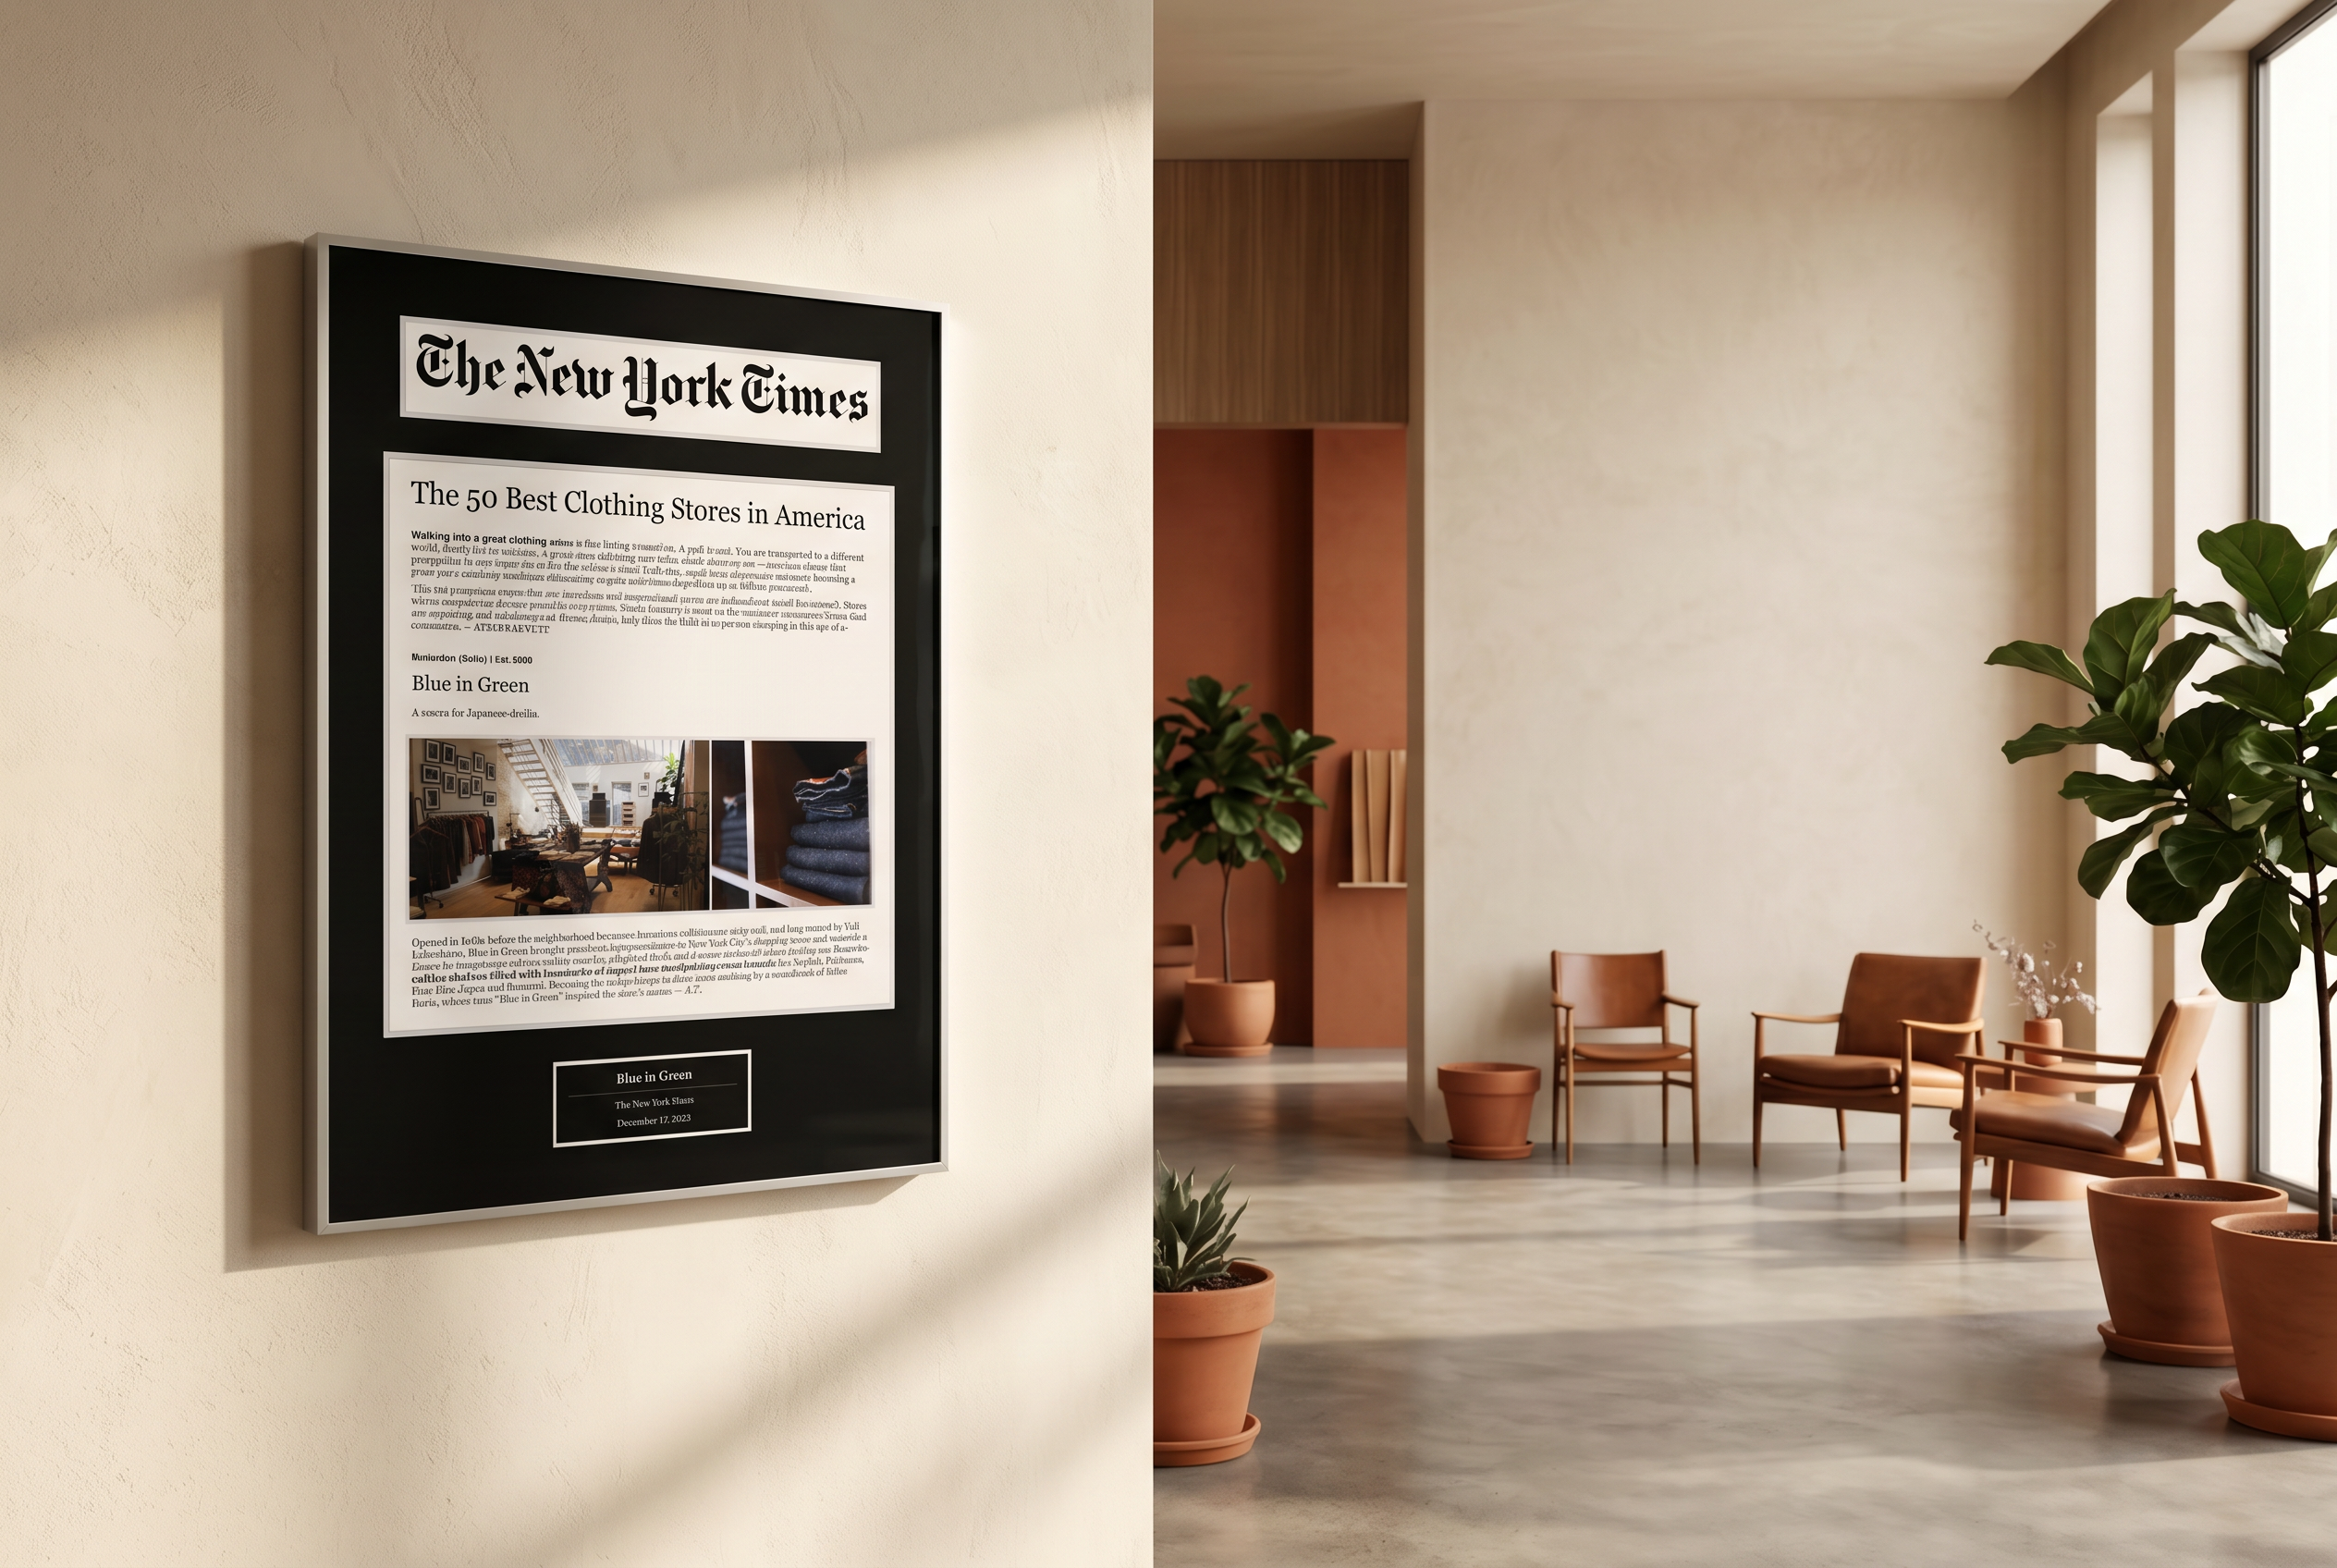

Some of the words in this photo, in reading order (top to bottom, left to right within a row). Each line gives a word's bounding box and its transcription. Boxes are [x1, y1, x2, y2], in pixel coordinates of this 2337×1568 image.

[416, 334, 507, 396] The
[514, 344, 614, 399] New
[623, 356, 735, 421] York
[741, 363, 868, 423] Times
[410, 481, 459, 506] The
[466, 489, 497, 512] 50
[506, 486, 557, 511] Best
[564, 490, 664, 524] Clothing
[671, 497, 740, 522] Stores
[748, 501, 768, 524] in
[774, 505, 865, 531] America
[411, 531, 449, 542] Walking
[453, 533, 471, 542] into
[483, 535, 507, 544] great
[509, 536, 546, 547] clothing
[604, 540, 630, 552] linting
[679, 545, 685, 553] A
[736, 547, 751, 556] You
[831, 552, 863, 561] different
[727, 607, 739, 616] the
[800, 622, 814, 631] this
[831, 623, 839, 631] of
[459, 655, 487, 664] (Solio)
[496, 655, 511, 664] Est.
[412, 675, 451, 691] Blue
[457, 676, 472, 692] in
[478, 677, 529, 692] Green
[412, 708, 419, 717] A
[452, 708, 464, 717] for
[412, 937, 447, 949] Opened
[449, 937, 458, 946] in
[518, 935, 532, 943] the
[834, 924, 843, 932] by
[468, 949, 488, 957] Blue
[490, 948, 498, 956] in
[501, 947, 528, 956] Green
[519, 970, 541, 978] with
[753, 972, 764, 981] by
[816, 968, 825, 976] of
[495, 995, 519, 1003] "Blue
[532, 991, 563, 1002] Green"
[565, 990, 599, 1001] inspired
[603, 990, 616, 998] the
[617, 1072, 642, 1084] Blue
[645, 1072, 655, 1082] in
[659, 1071, 692, 1081] Green
[615, 1101, 630, 1109] The
[652, 1097, 670, 1107] York
[618, 1118, 657, 1127] December
[672, 1114, 691, 1122] 2023
